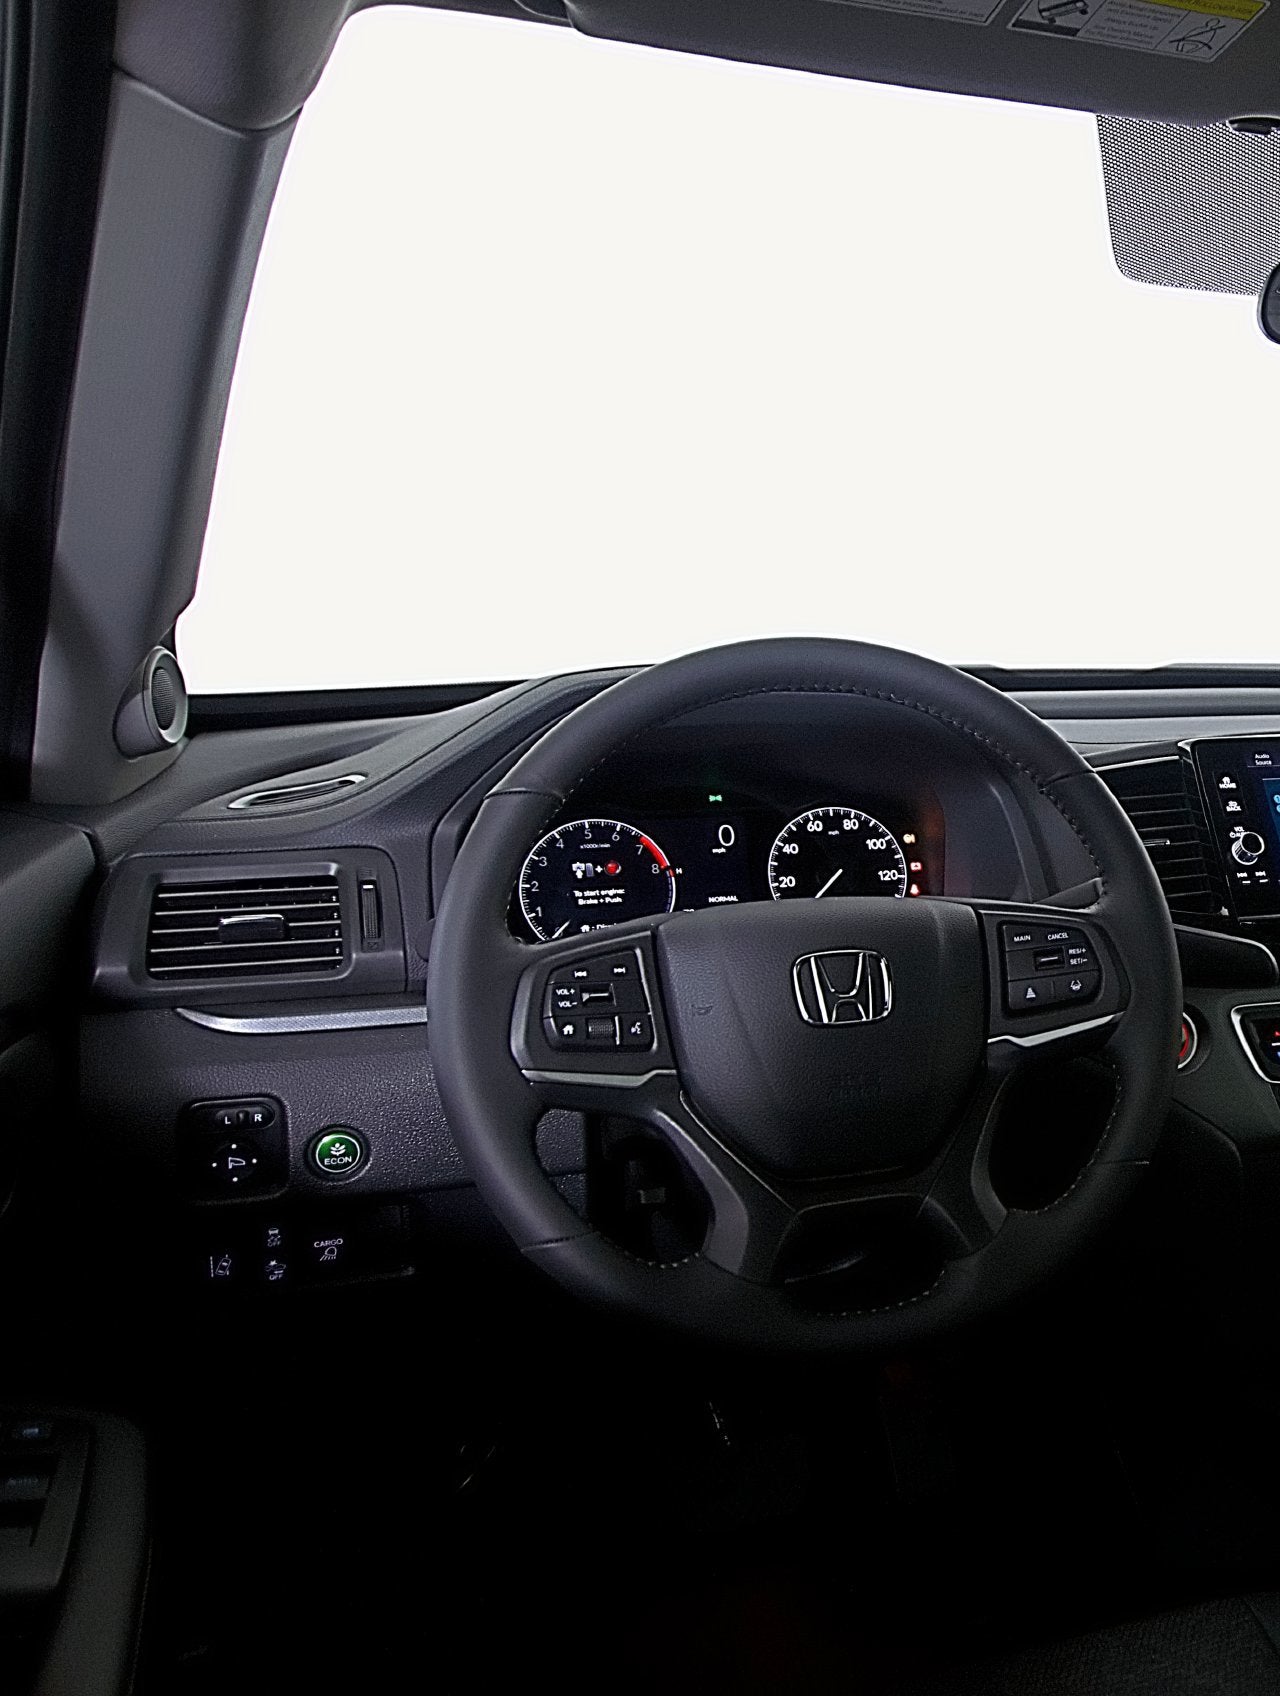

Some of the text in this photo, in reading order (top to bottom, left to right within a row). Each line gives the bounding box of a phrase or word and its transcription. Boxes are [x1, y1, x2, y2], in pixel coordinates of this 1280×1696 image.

[807, 820, 823, 832] 60
[843, 818, 859, 830] 80
[585, 828, 592, 839] 5
[612, 831, 620, 841] 6
[718, 824, 735, 846] 0
[555, 838, 564, 849] 4
[782, 843, 799, 854] 40
[865, 838, 886, 850] 100
[635, 844, 644, 855] 7
[539, 856, 547, 867] 3
[651, 863, 660, 874] 8
[877, 869, 898, 881] 120
[531, 880, 539, 891] 2
[779, 876, 796, 888] 20
[584, 889, 600, 897] start
[605, 896, 622, 904] Push
[708, 895, 739, 903] NORMAL
[535, 906, 542, 917] 1
[1047, 932, 1069, 940] CANCEL
[224, 1115, 231, 1125] L
[254, 1113, 262, 1122] R
[324, 1155, 353, 1166] ECON
[313, 1237, 344, 1248] CARGO
